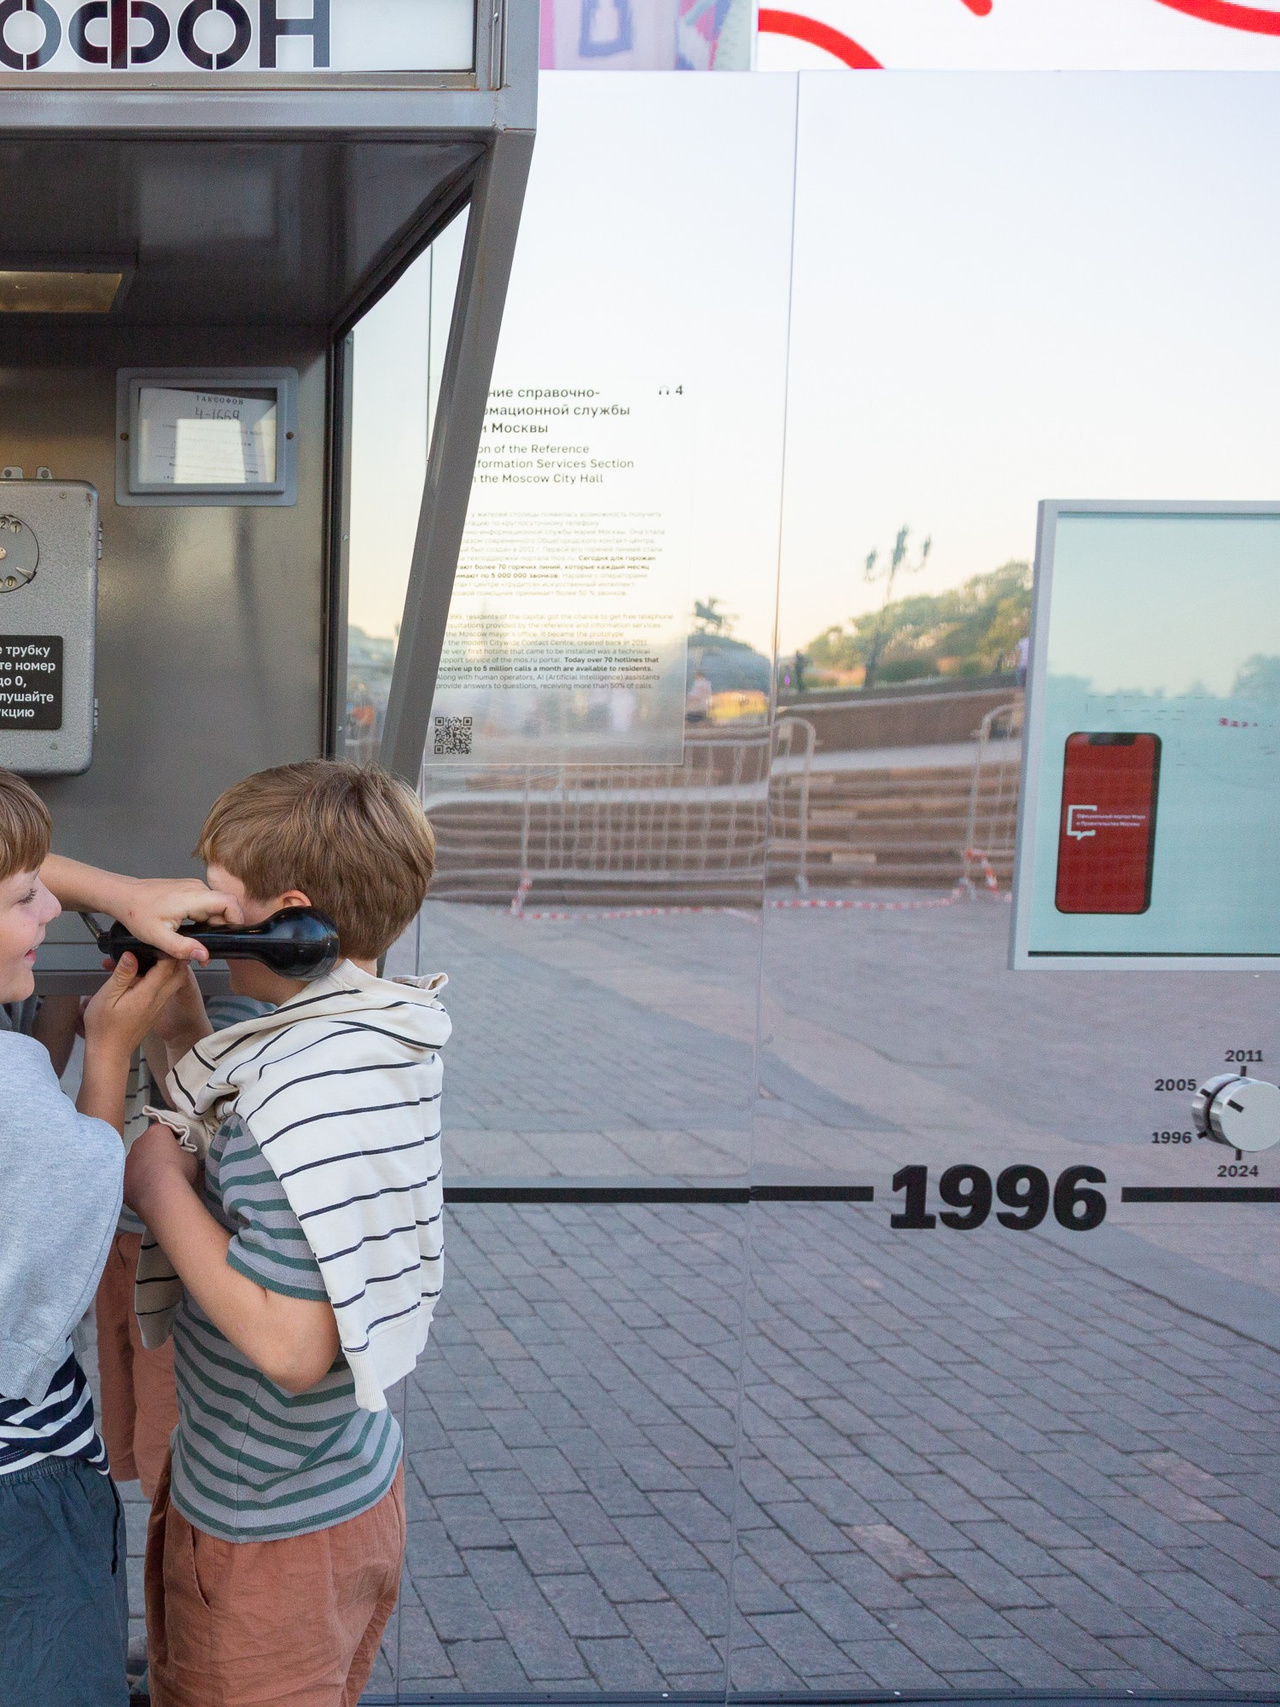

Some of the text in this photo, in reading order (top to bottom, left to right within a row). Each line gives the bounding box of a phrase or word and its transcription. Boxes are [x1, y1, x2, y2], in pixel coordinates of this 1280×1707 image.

[488, 385, 683, 400] ние справочно- 4
[196, 394, 244, 405] ТАКСОФОН
[485, 404, 630, 418] мационной службы
[492, 422, 548, 433] Москвы
[477, 444, 590, 454] on of the Reference
[477, 458, 634, 468] formation Services Section
[480, 473, 499, 483] the
[502, 473, 550, 483] Moscow
[553, 473, 576, 485] City
[580, 473, 603, 483] Hall
[0, 520, 6, 530] 2
[13, 524, 18, 534] 1
[7, 579, 14, 587] 0
[6, 645, 51, 658] трубку
[15, 661, 56, 673] номер
[14, 675, 27, 688] 0,
[1224, 1050, 1263, 1062] 2011
[1154, 1078, 1197, 1091] 2005
[1151, 1131, 1192, 1144] 1996
[1217, 1165, 1259, 1177] 2024
[890, 1163, 1108, 1232] 1996
